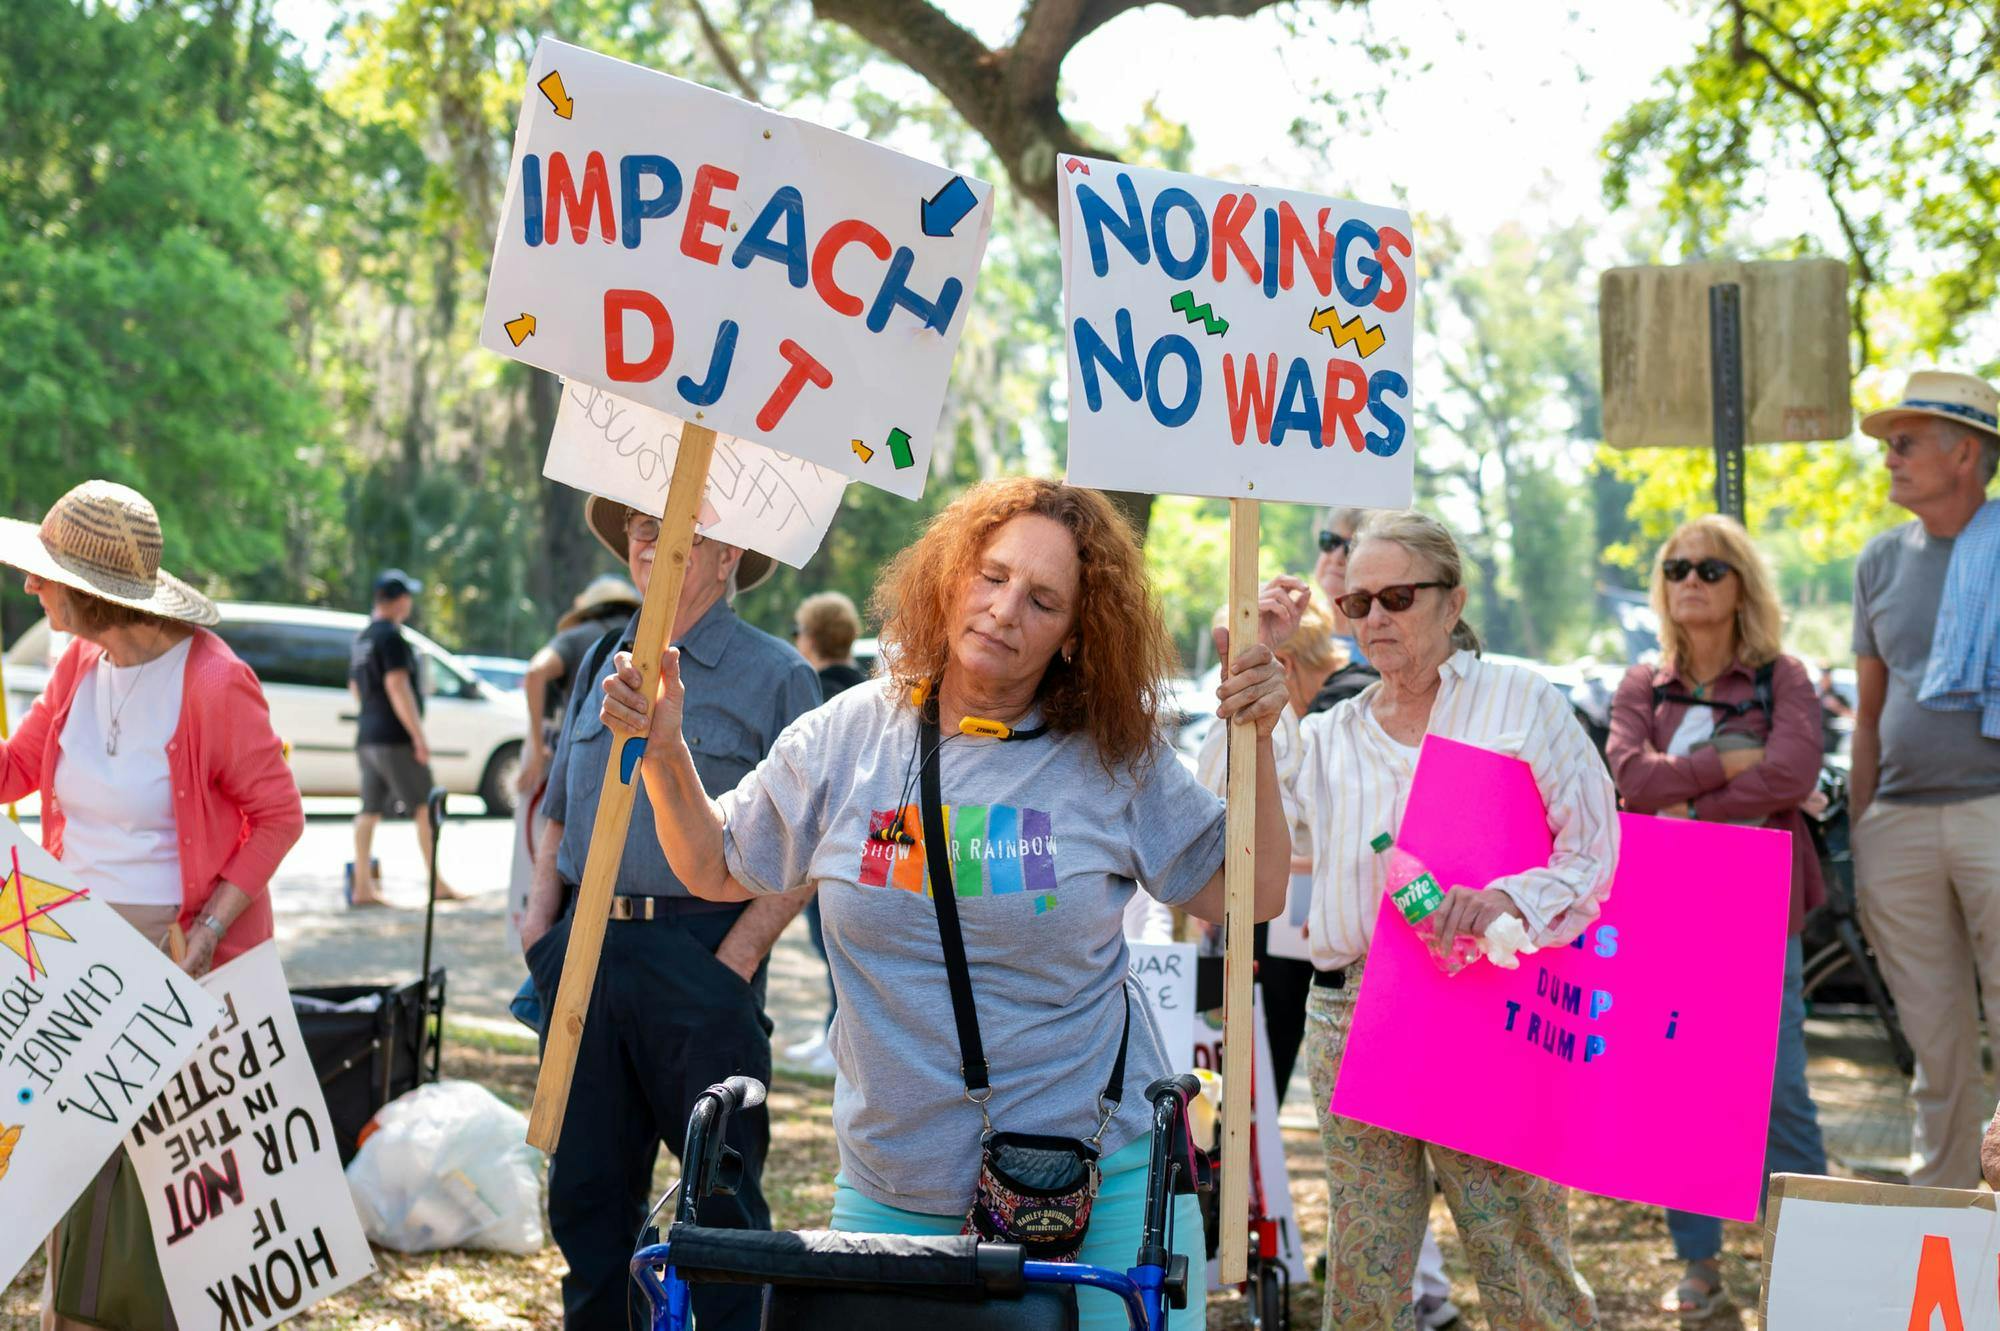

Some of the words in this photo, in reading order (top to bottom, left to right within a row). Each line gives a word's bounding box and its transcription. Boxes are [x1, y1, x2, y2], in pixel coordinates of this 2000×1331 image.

[521, 149, 964, 336] IMPEACH
[1075, 172, 1210, 281] NO
[1211, 192, 1412, 314] KINGS
[1073, 307, 1203, 429] NO
[1222, 352, 1409, 458] WARS
[859, 839, 911, 861] SHOW
[969, 835, 1058, 862] RAINBOW
[9, 964, 124, 1094] CHANGE
[1504, 999, 1607, 1064] TRUMP
[1537, 966, 1613, 1021] DUMP
[57, 978, 193, 1124] ALEXA,
[131, 1016, 287, 1146] EPSTEIN
[165, 1107, 242, 1175] THE
[243, 1082, 279, 1120] IN
[253, 1107, 321, 1176] UR
[164, 1148, 245, 1246] NOT
[252, 1198, 287, 1250] IF
[1015, 1209, 1074, 1229] HARLEY-DAVIDSON
[205, 1226, 338, 1331] HONK
